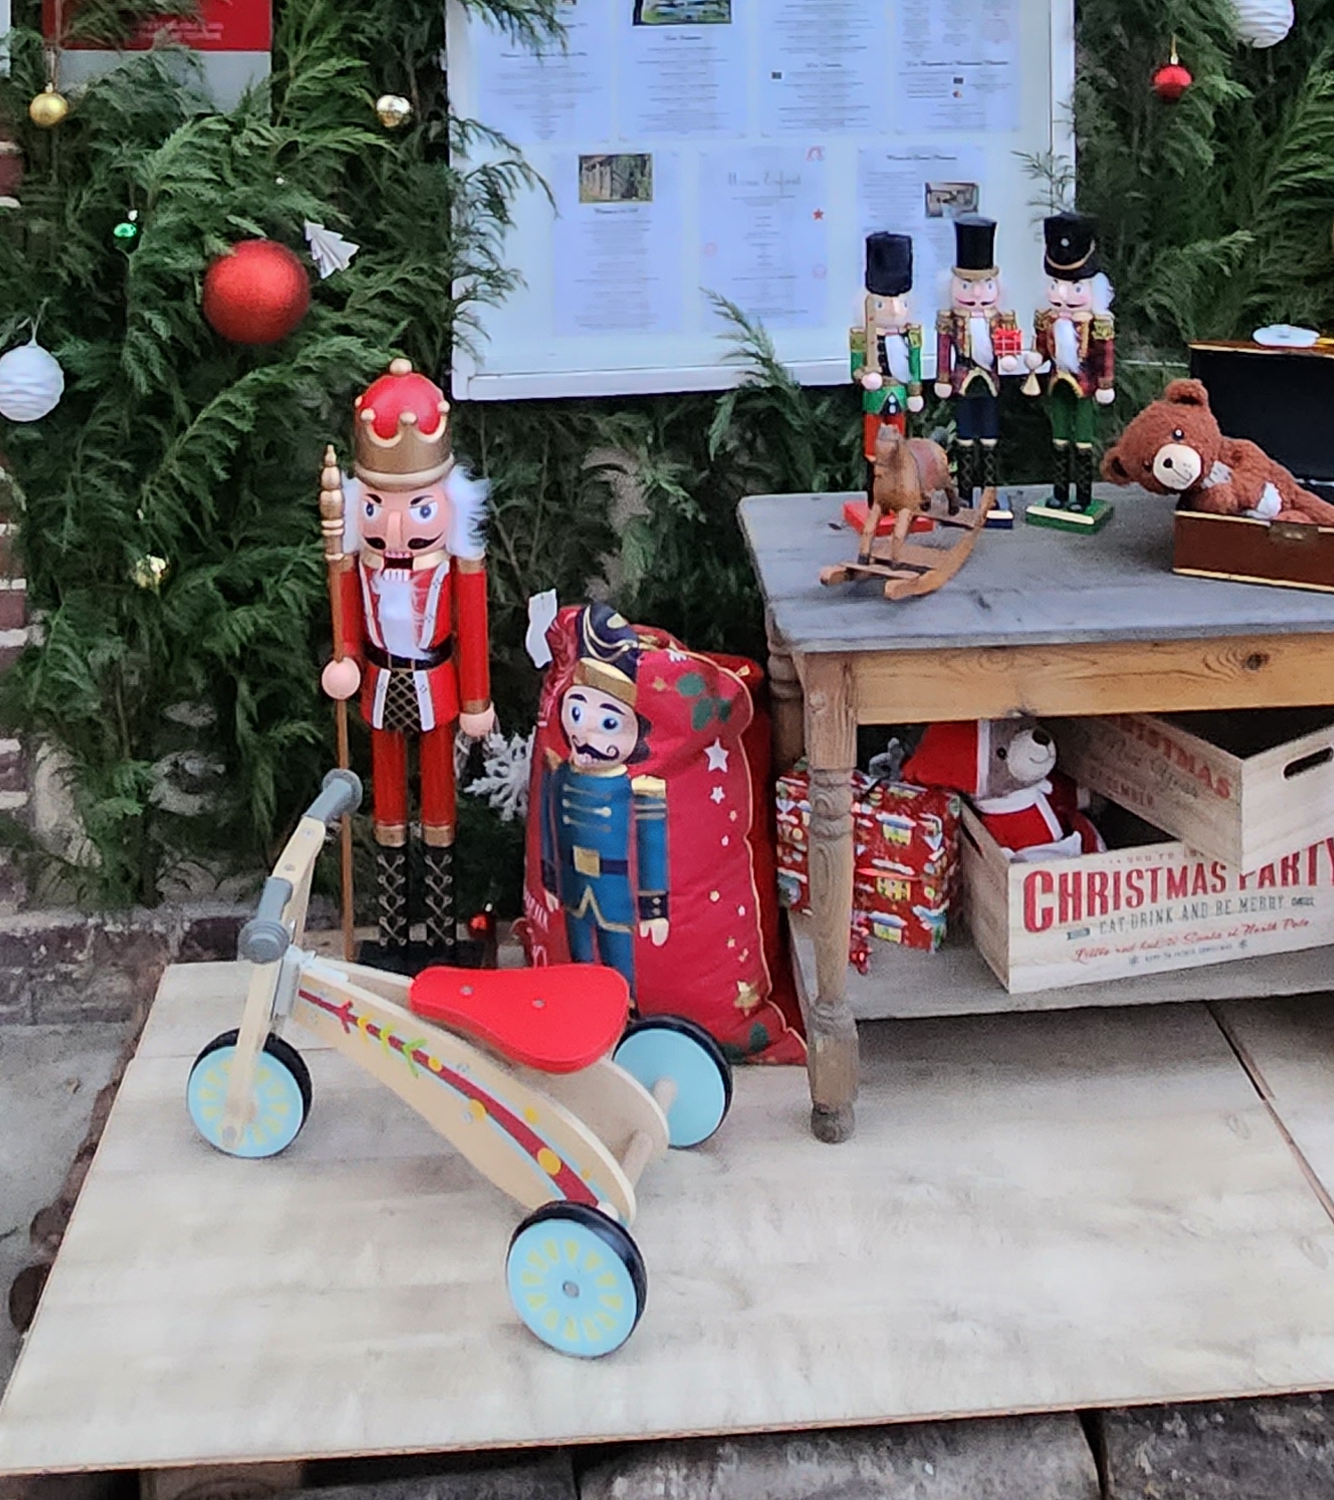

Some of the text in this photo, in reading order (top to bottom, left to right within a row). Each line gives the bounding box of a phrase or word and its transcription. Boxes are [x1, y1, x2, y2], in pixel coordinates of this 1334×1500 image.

[1023, 861, 1227, 933] CHRISTMAS
[1182, 902, 1209, 921] AND
[1216, 899, 1232, 916] BE
